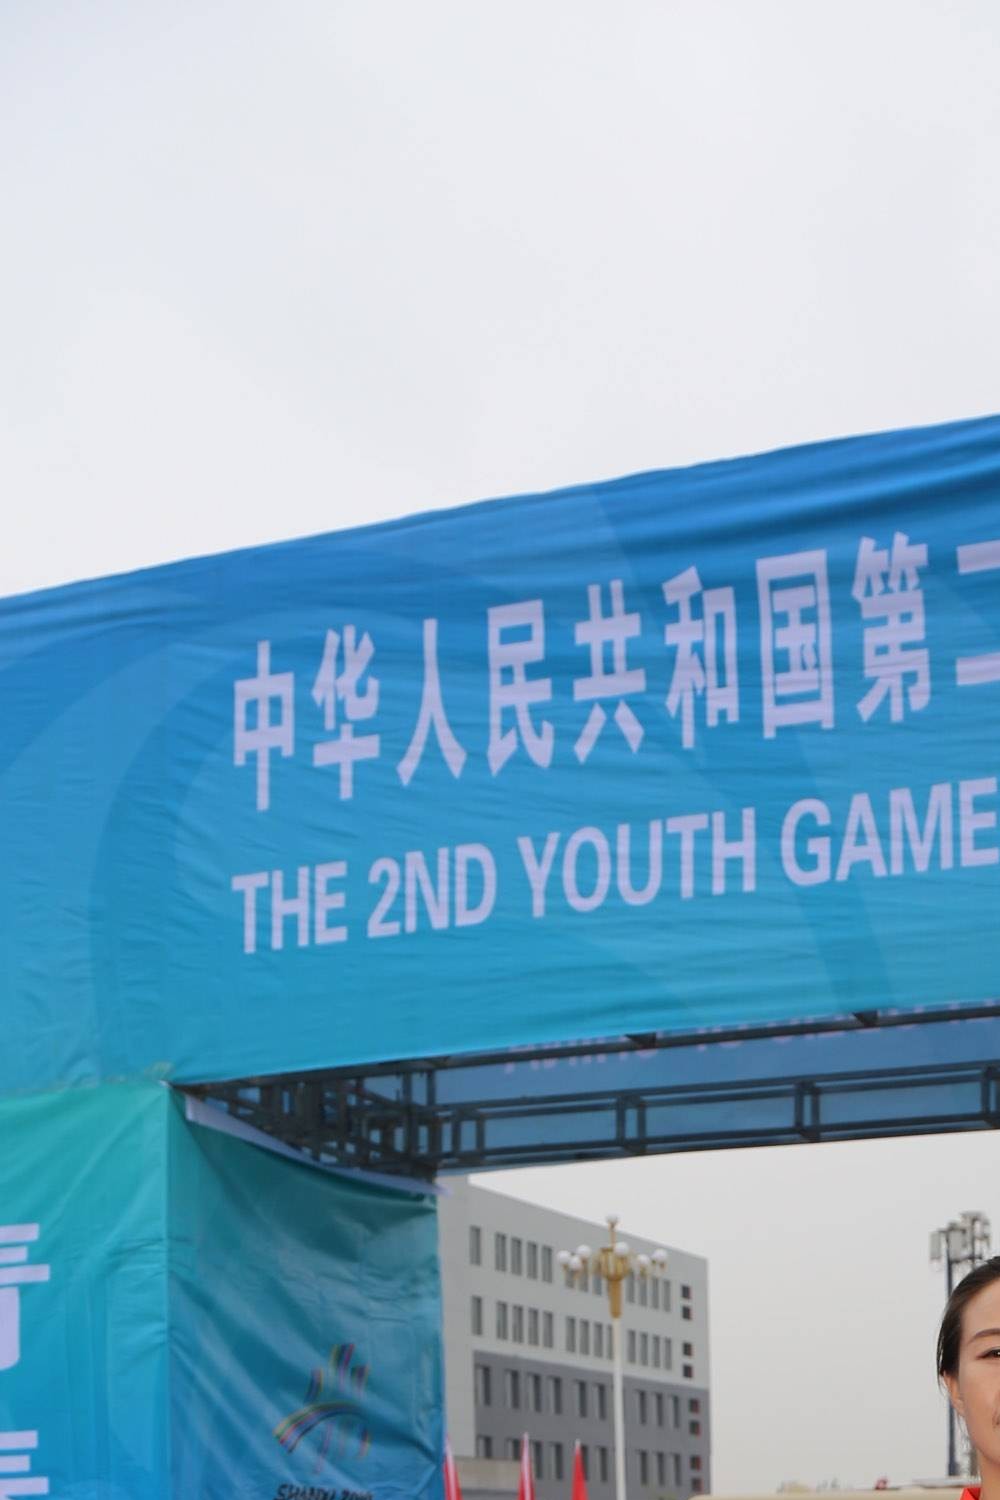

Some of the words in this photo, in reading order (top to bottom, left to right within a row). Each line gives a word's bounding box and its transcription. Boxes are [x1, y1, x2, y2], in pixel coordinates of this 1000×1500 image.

[231, 861, 348, 954] THE
[367, 842, 497, 938] 2ND
[518, 807, 756, 918] YOUTH
